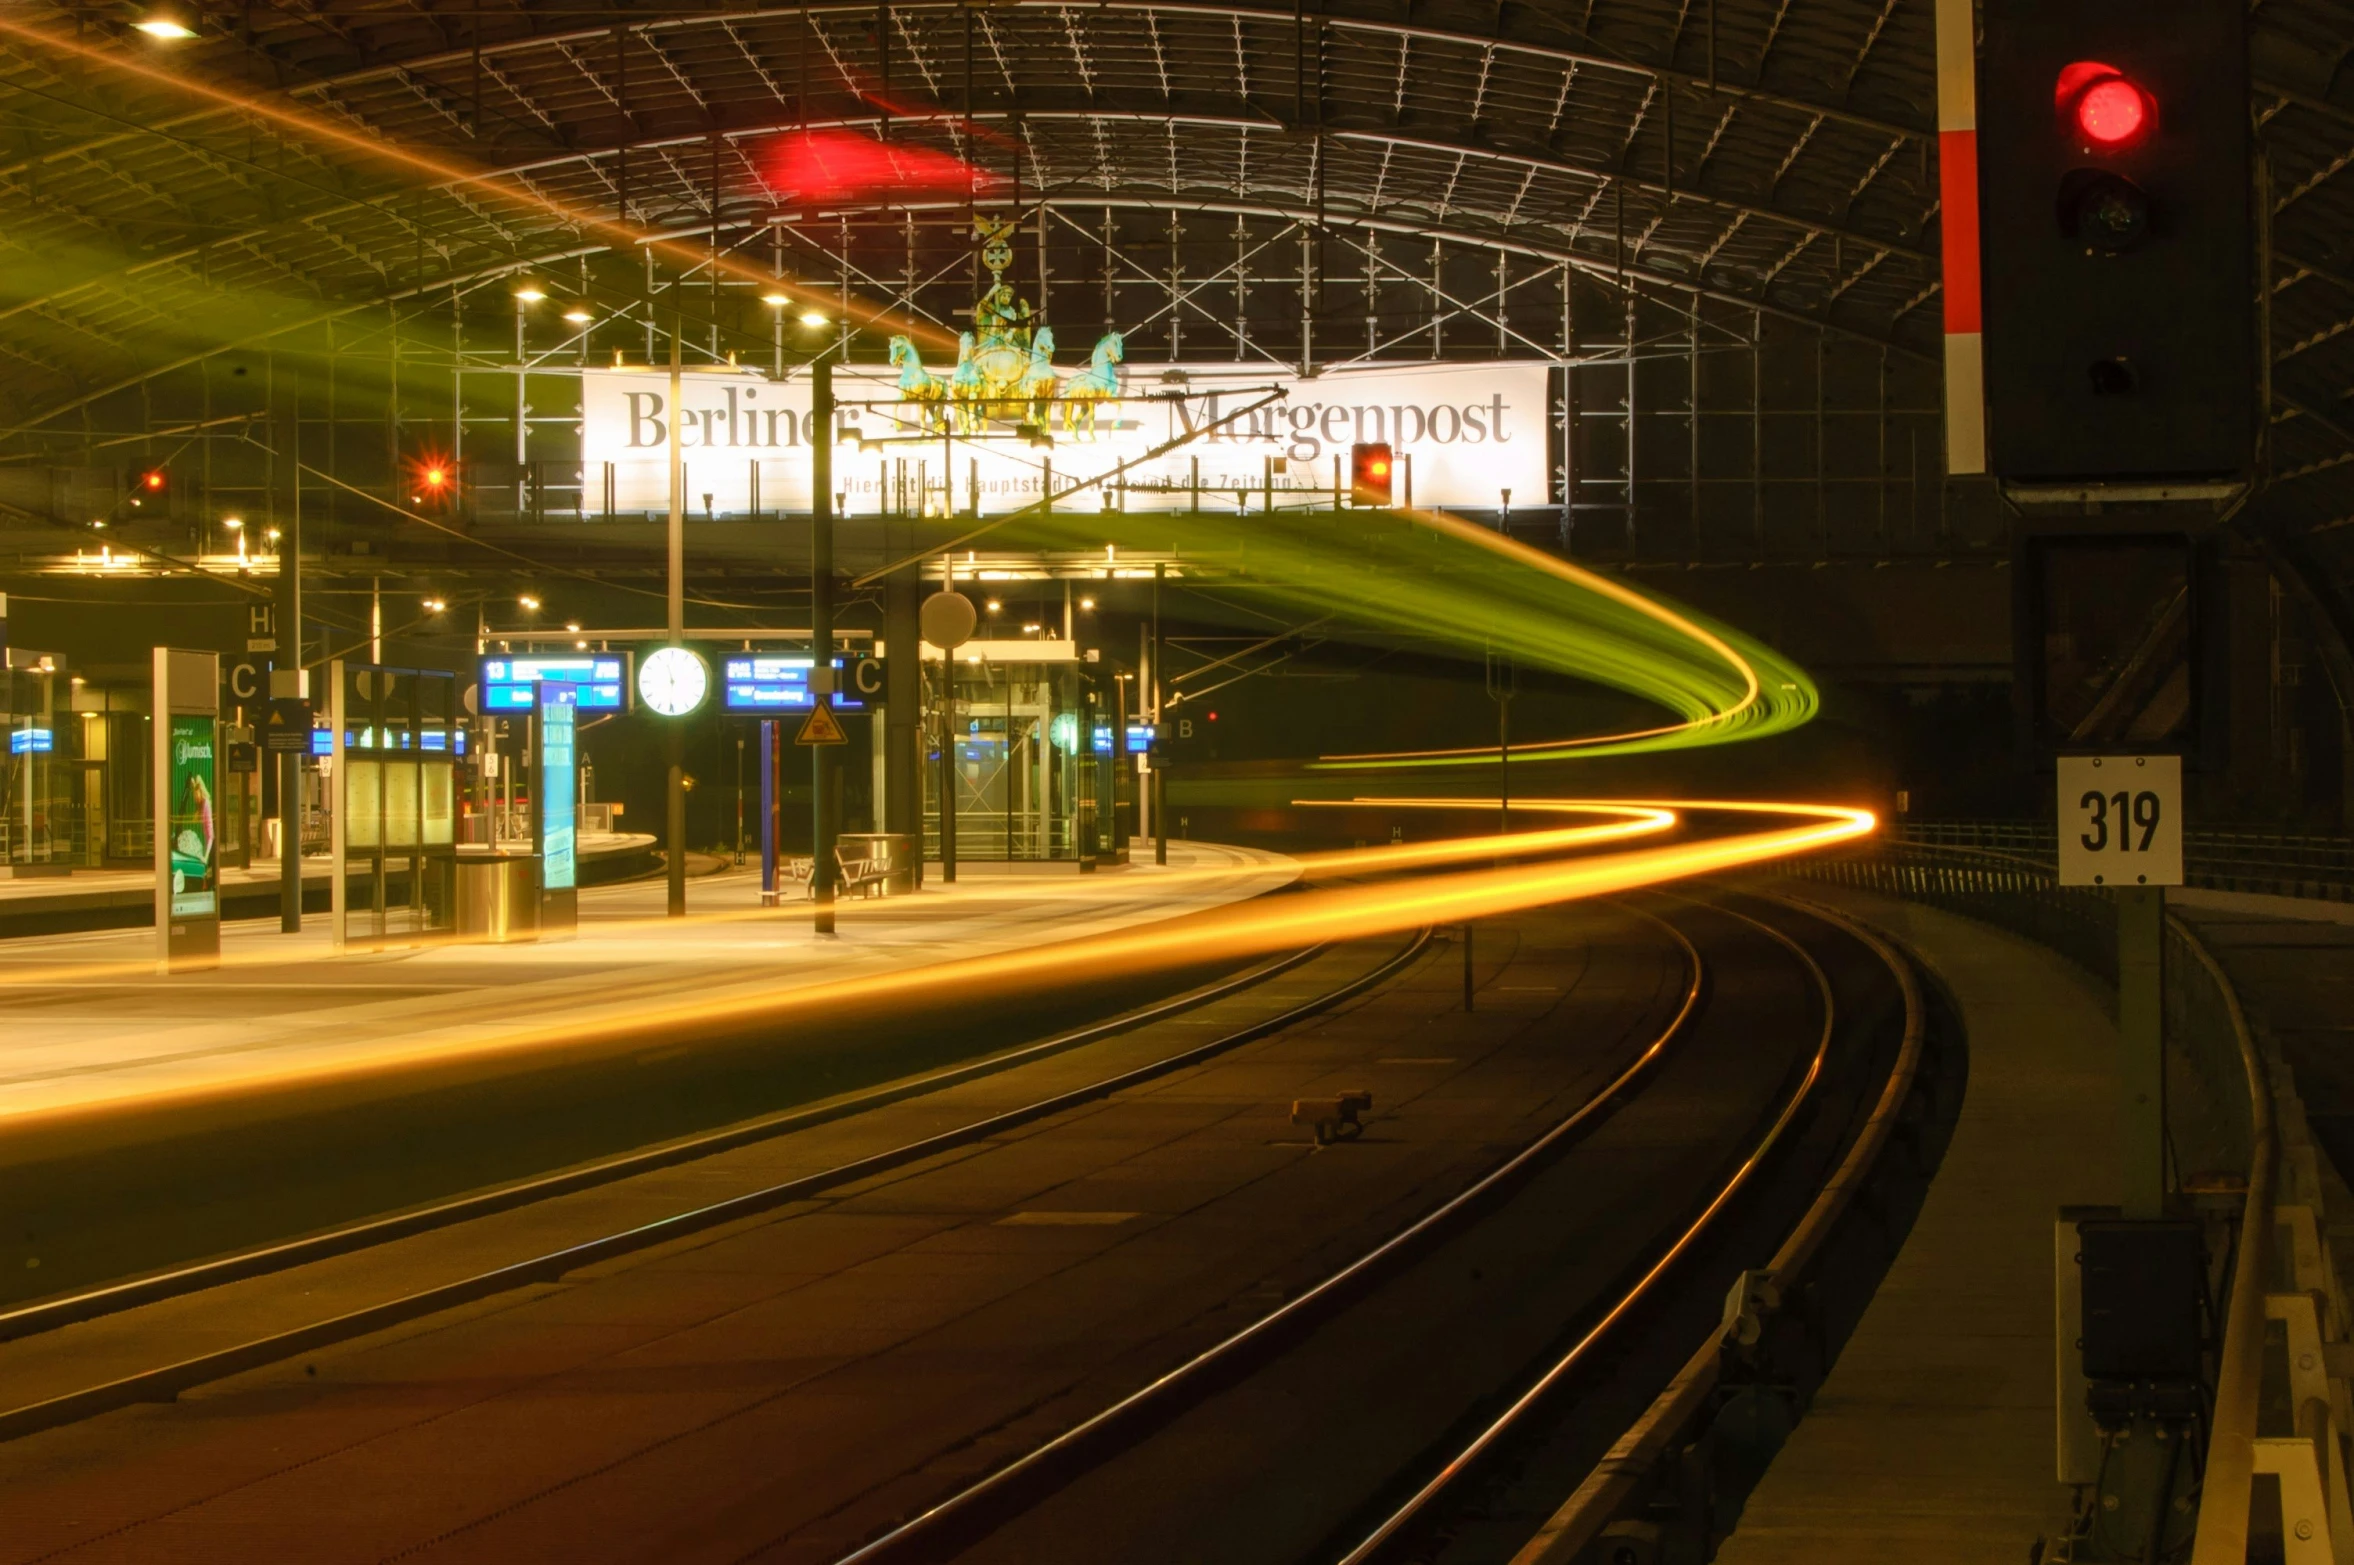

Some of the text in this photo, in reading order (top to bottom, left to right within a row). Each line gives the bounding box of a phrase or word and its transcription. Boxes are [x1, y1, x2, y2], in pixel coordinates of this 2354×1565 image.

[1162, 389, 1512, 462] Morgenpost
[926, 476, 954, 493] di
[1181, 474, 1209, 492] de
[250, 606, 269, 633] H
[231, 663, 257, 698] C
[856, 658, 882, 694] C
[1179, 719, 1193, 738] B
[1392, 826, 1401, 838] H
[2080, 790, 2161, 852] 319
[735, 852, 745, 864] H
